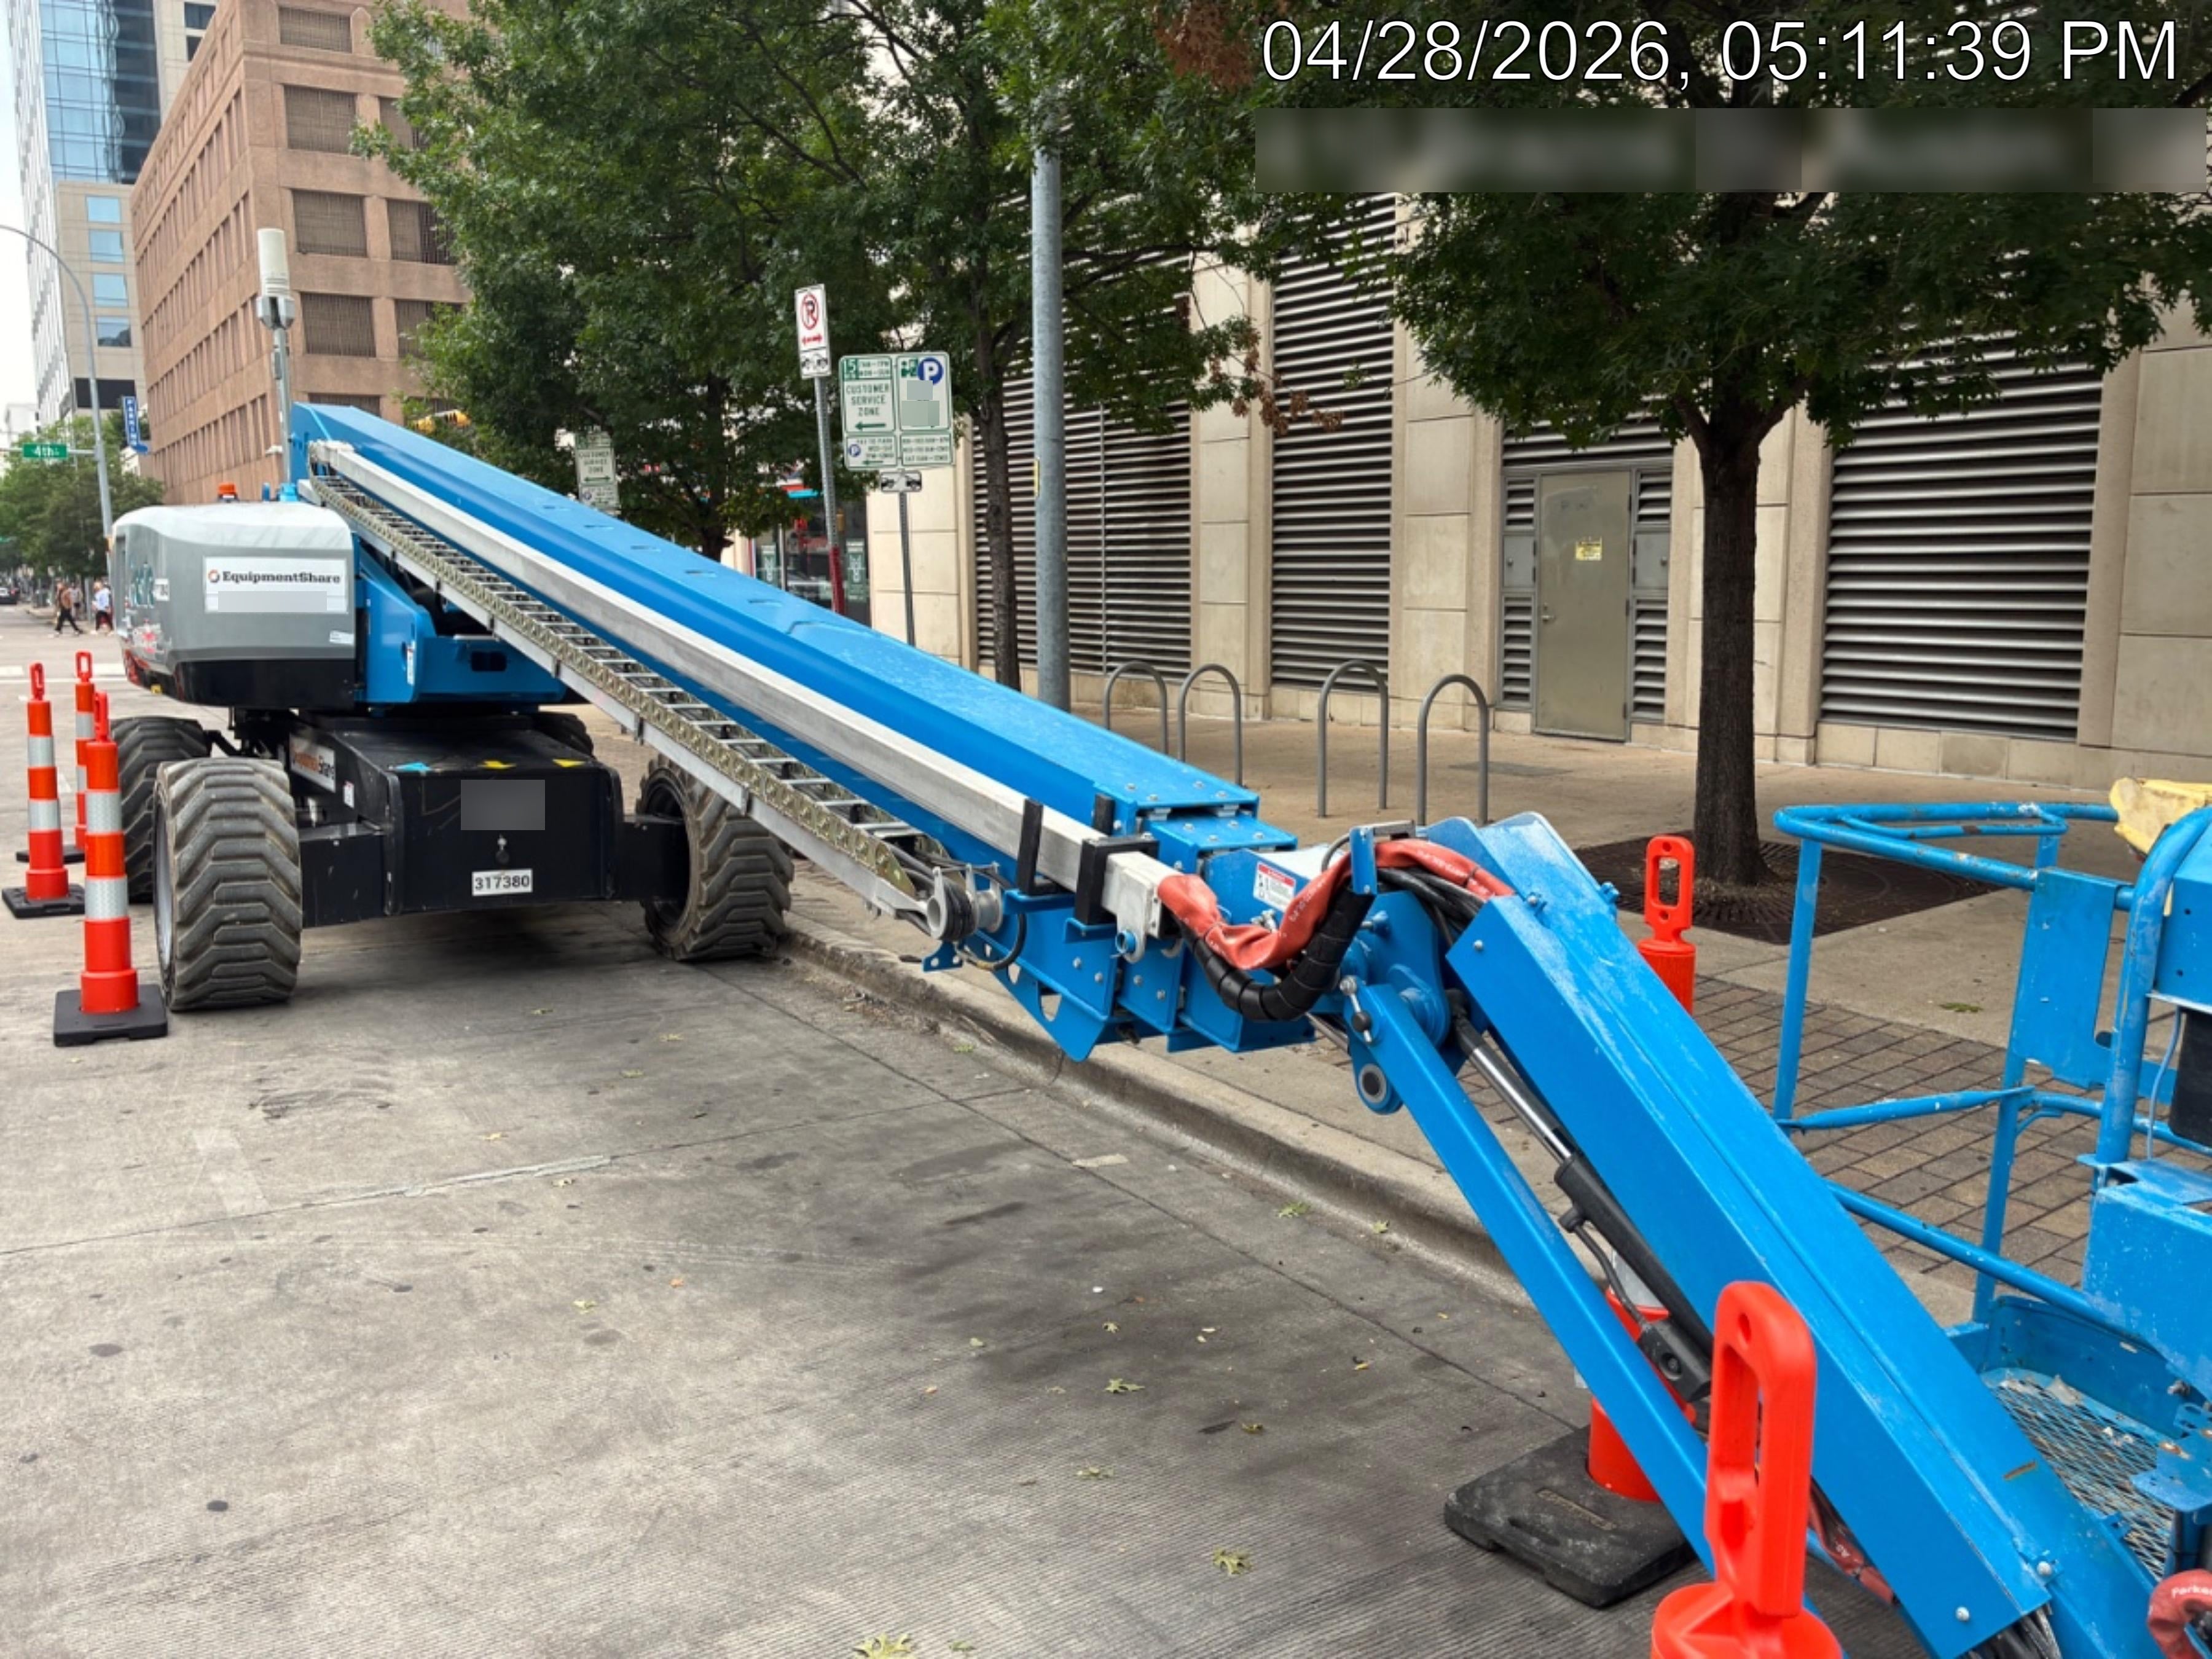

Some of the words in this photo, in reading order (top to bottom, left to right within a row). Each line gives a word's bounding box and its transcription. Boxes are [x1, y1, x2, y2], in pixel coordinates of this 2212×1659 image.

[846, 383, 889, 394] CUSTOMER
[851, 394, 886, 405] SERVICE
[858, 407, 880, 417] ZONE
[222, 570, 340, 584] EquipmentShare
[474, 875, 530, 890] 317380
